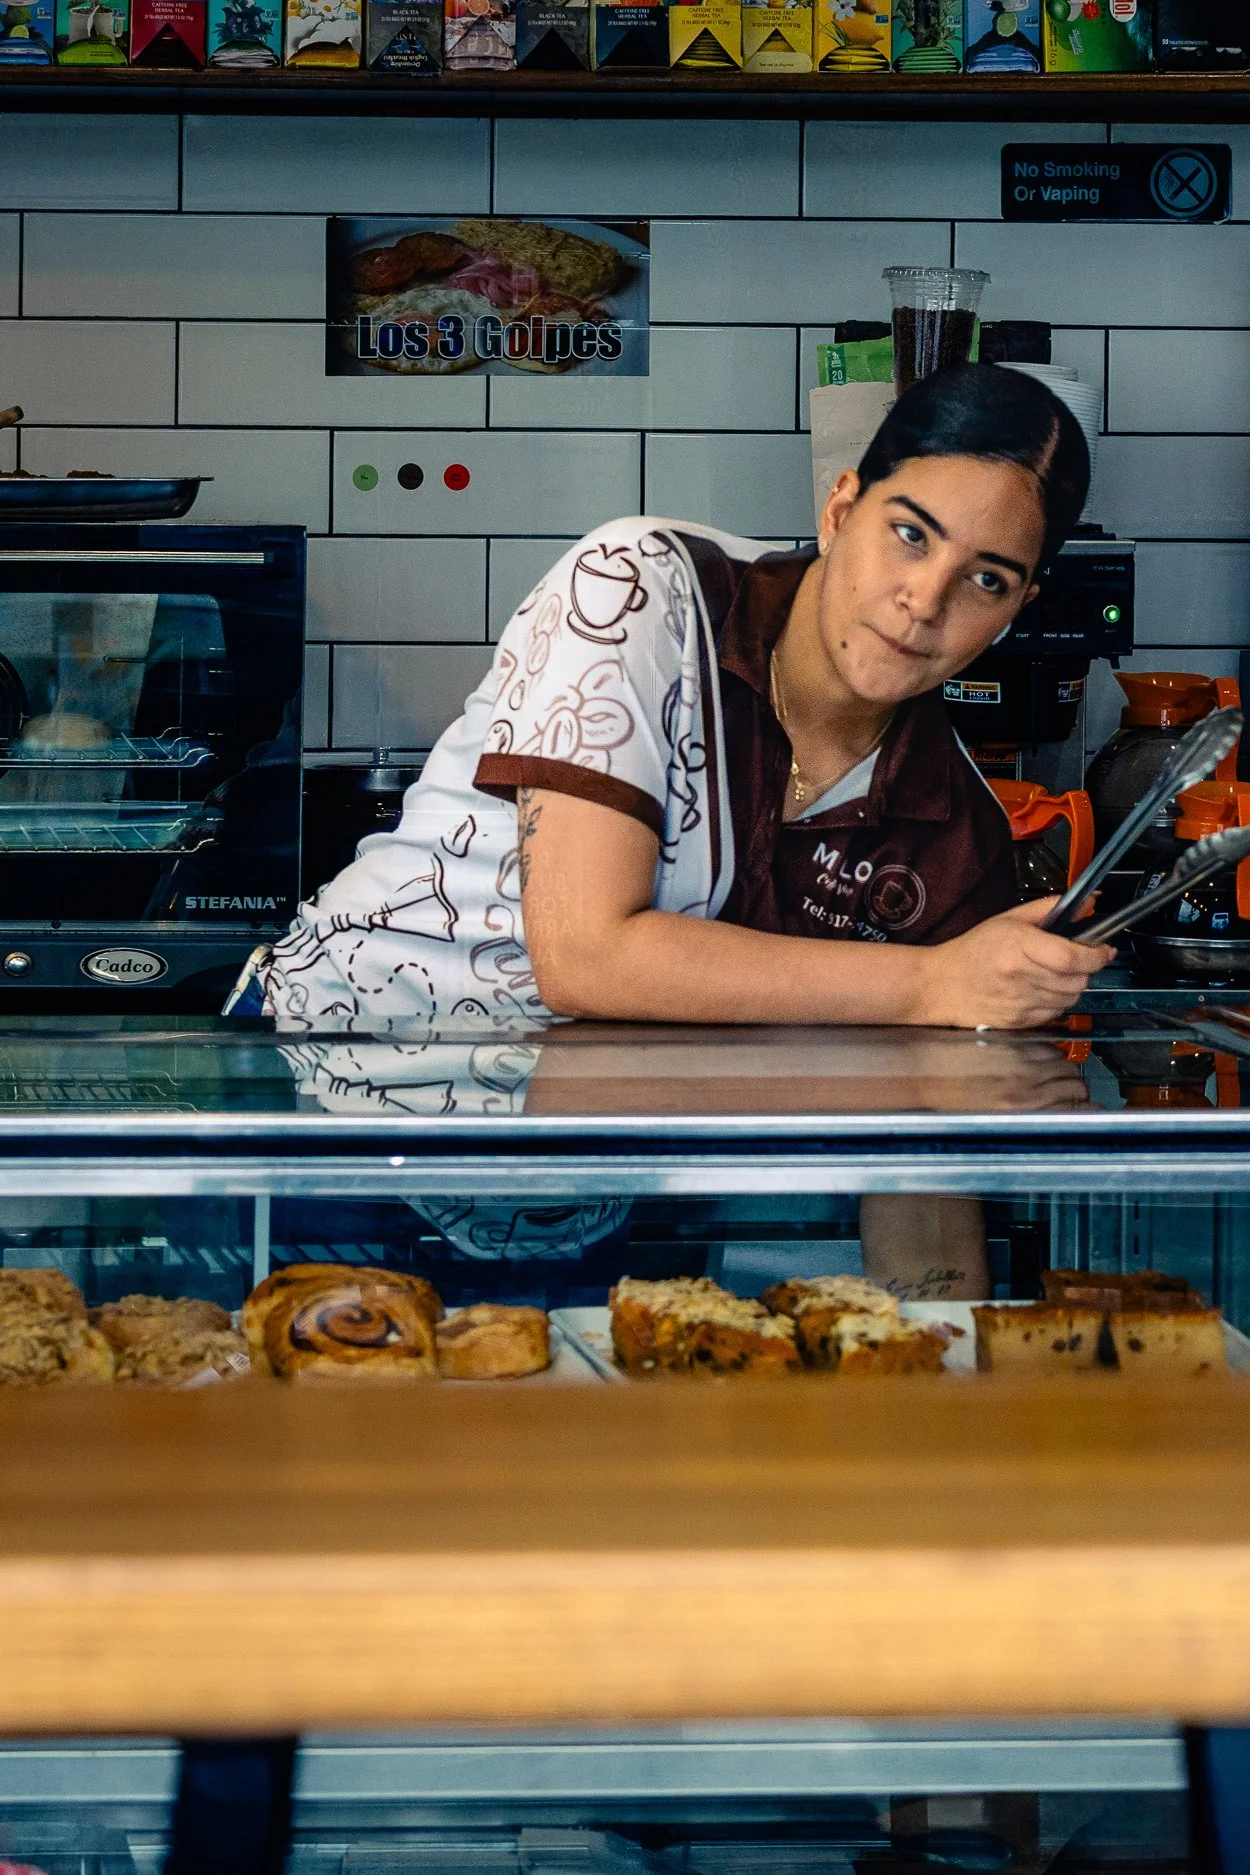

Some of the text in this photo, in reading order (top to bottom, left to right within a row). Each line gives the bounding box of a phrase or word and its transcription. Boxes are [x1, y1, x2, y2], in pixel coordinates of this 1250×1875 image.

[1014, 162, 1120, 180] No Smoking
[1014, 186, 1100, 204] Or Vaping
[356, 314, 623, 364] Los 3 Golpes
[832, 370, 843, 380] 20
[812, 841, 874, 884] MLO
[803, 896, 827, 921] Tel:
[96, 958, 154, 973] Cadco
